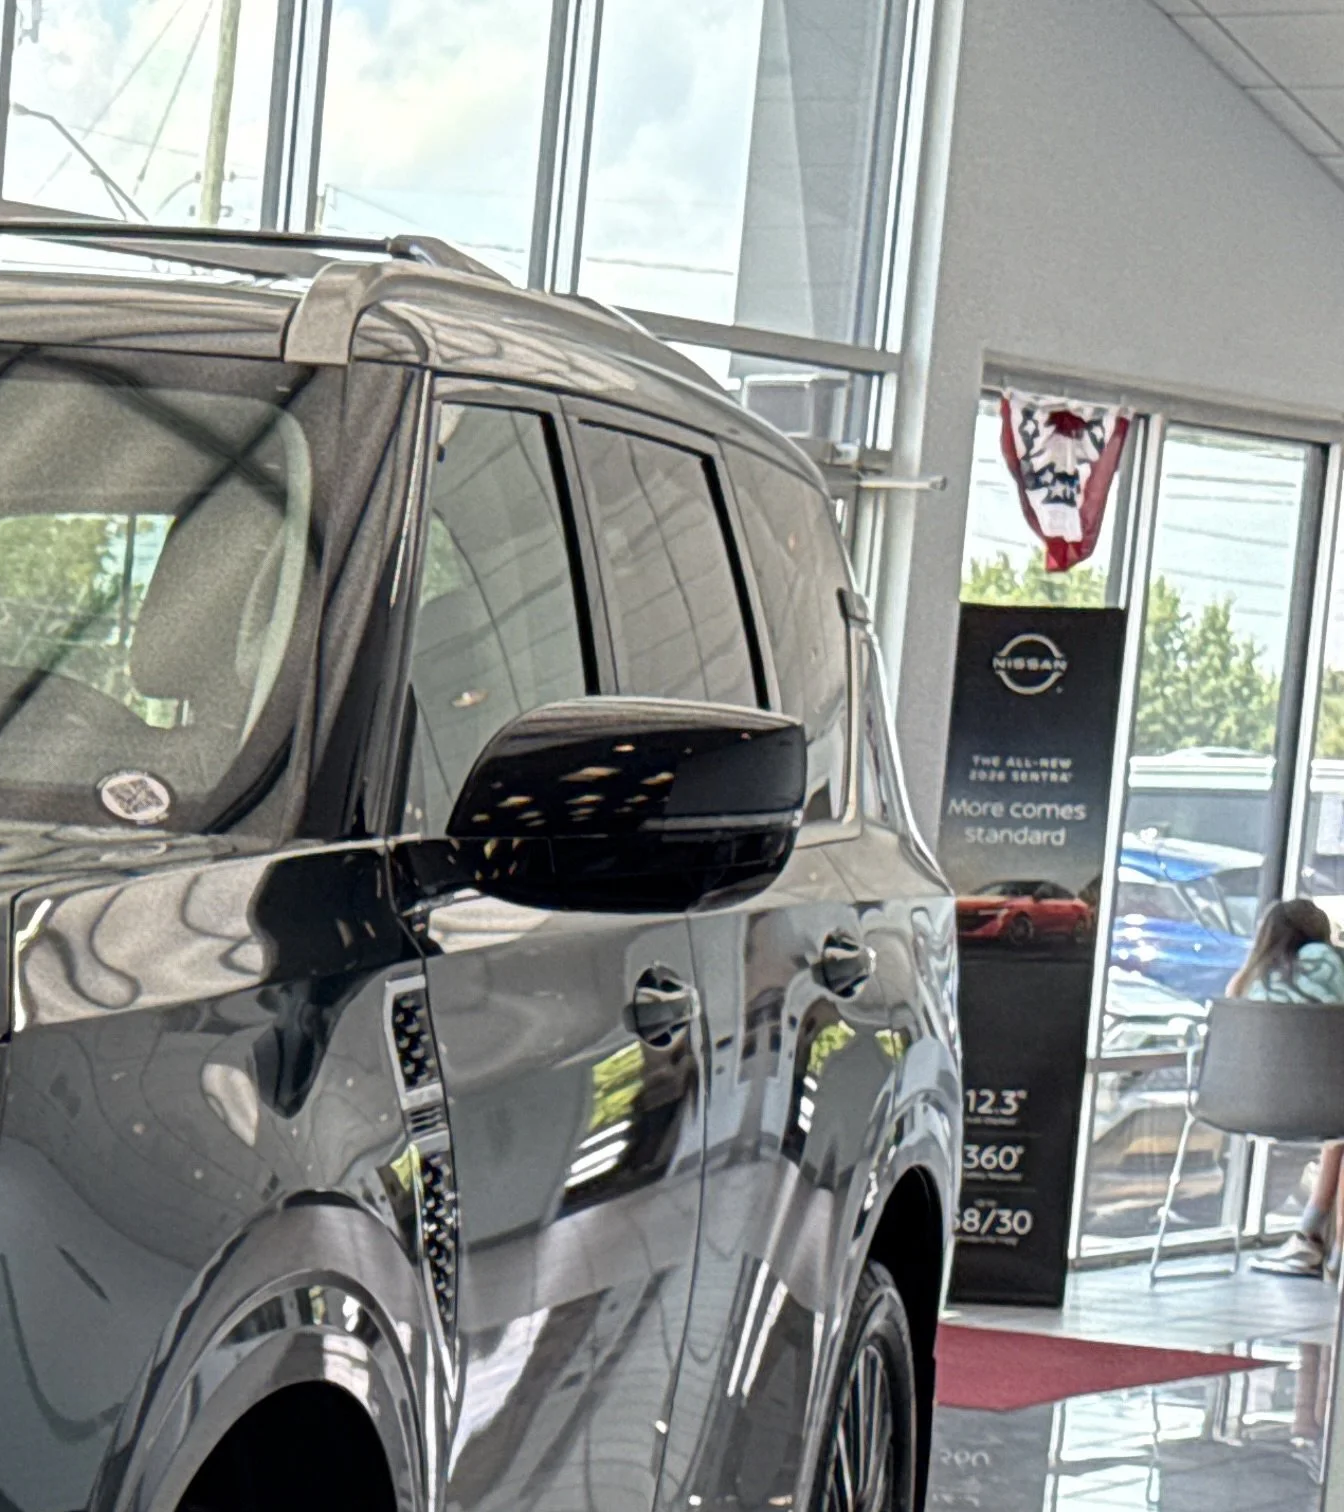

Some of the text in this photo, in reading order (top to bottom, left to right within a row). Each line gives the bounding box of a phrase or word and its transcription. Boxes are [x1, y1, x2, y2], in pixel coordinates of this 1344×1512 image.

[992, 657, 1068, 671] NISSAN
[972, 755, 1072, 769] THE ALL-NEW
[948, 798, 1087, 821] More comes
[964, 826, 1067, 847] standard
